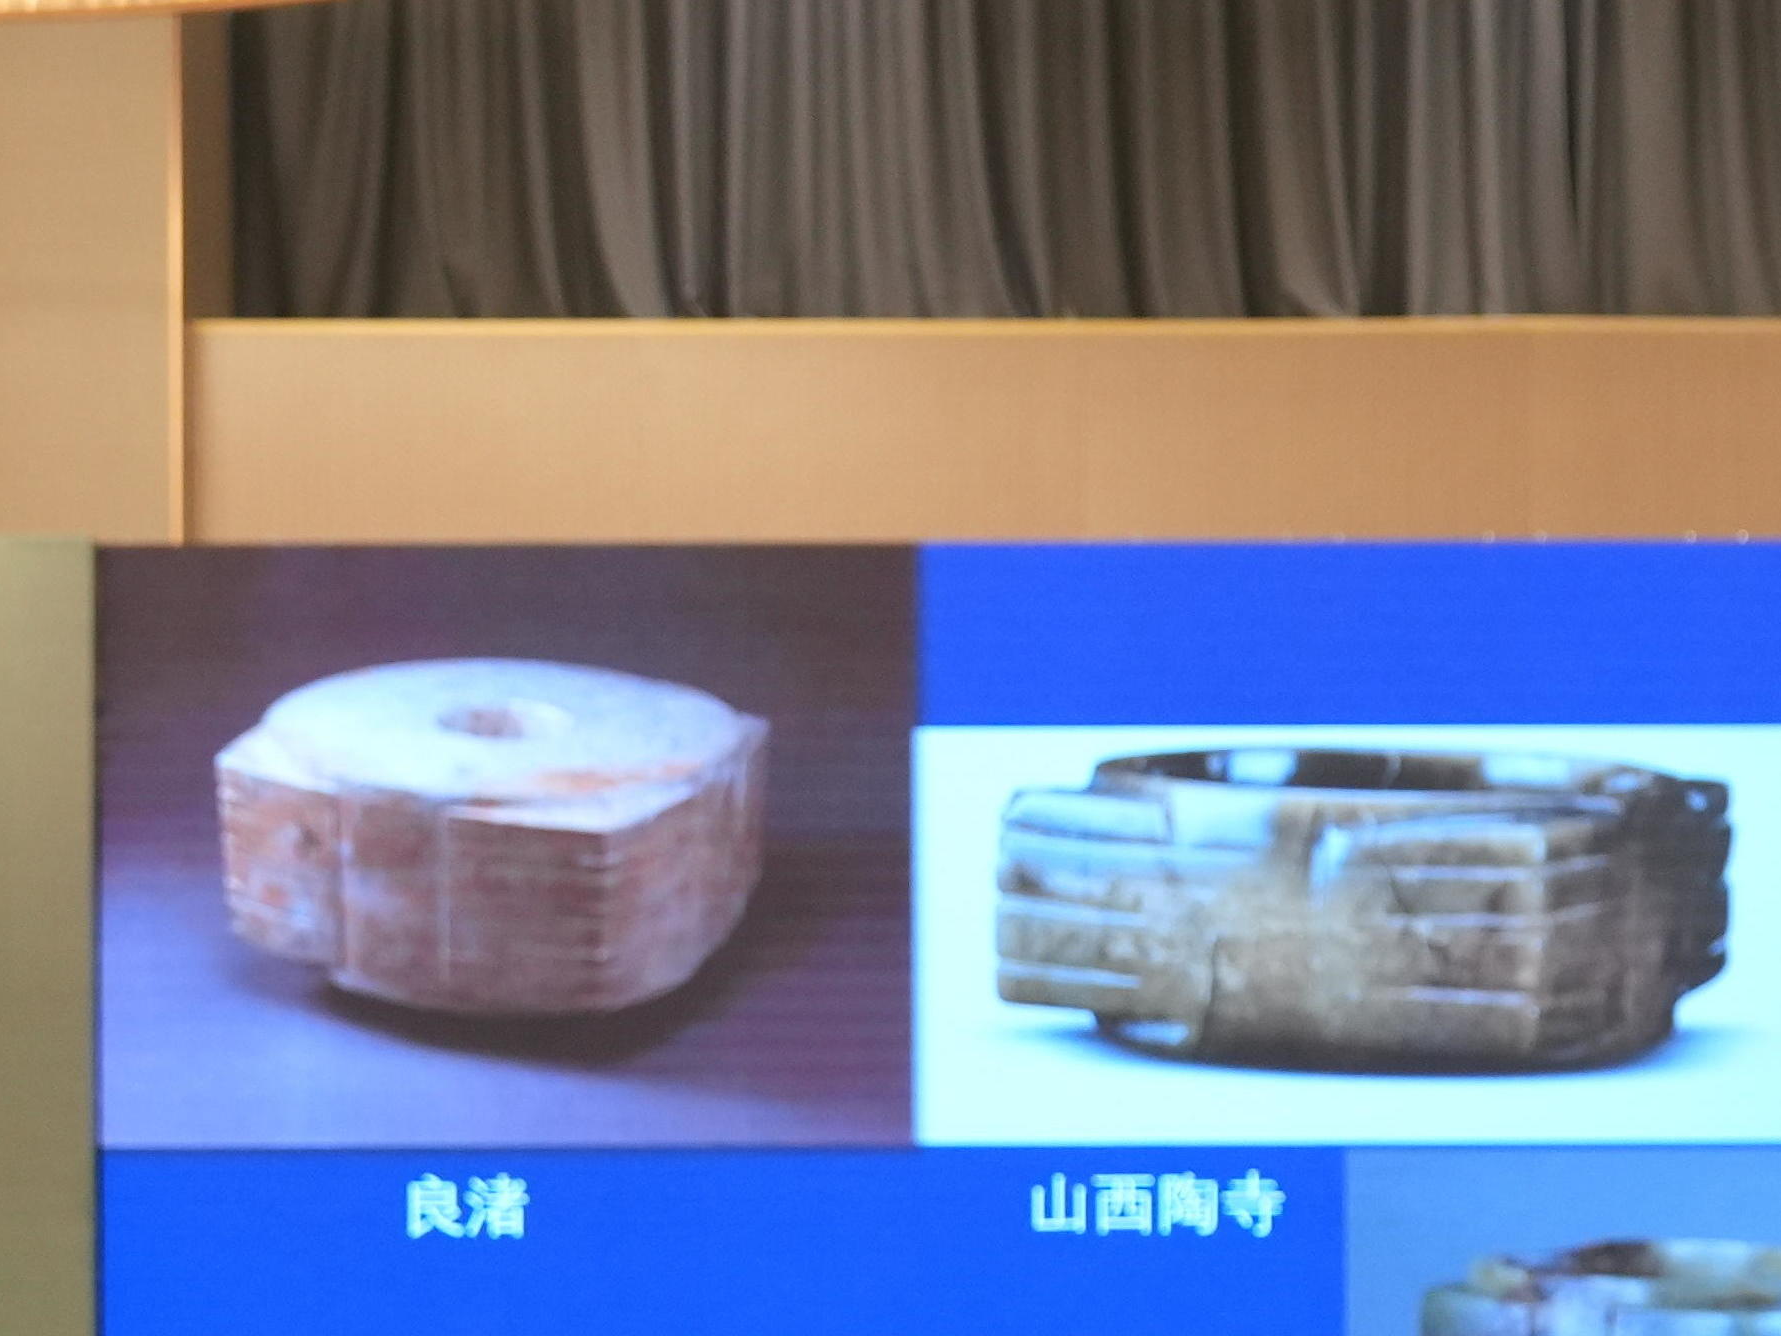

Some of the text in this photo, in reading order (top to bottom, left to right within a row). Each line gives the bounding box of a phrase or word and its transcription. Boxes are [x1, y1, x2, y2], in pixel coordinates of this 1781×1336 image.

[405, 1172, 530, 1239] 良渚
[1029, 1168, 1286, 1238] 山西陶寺
